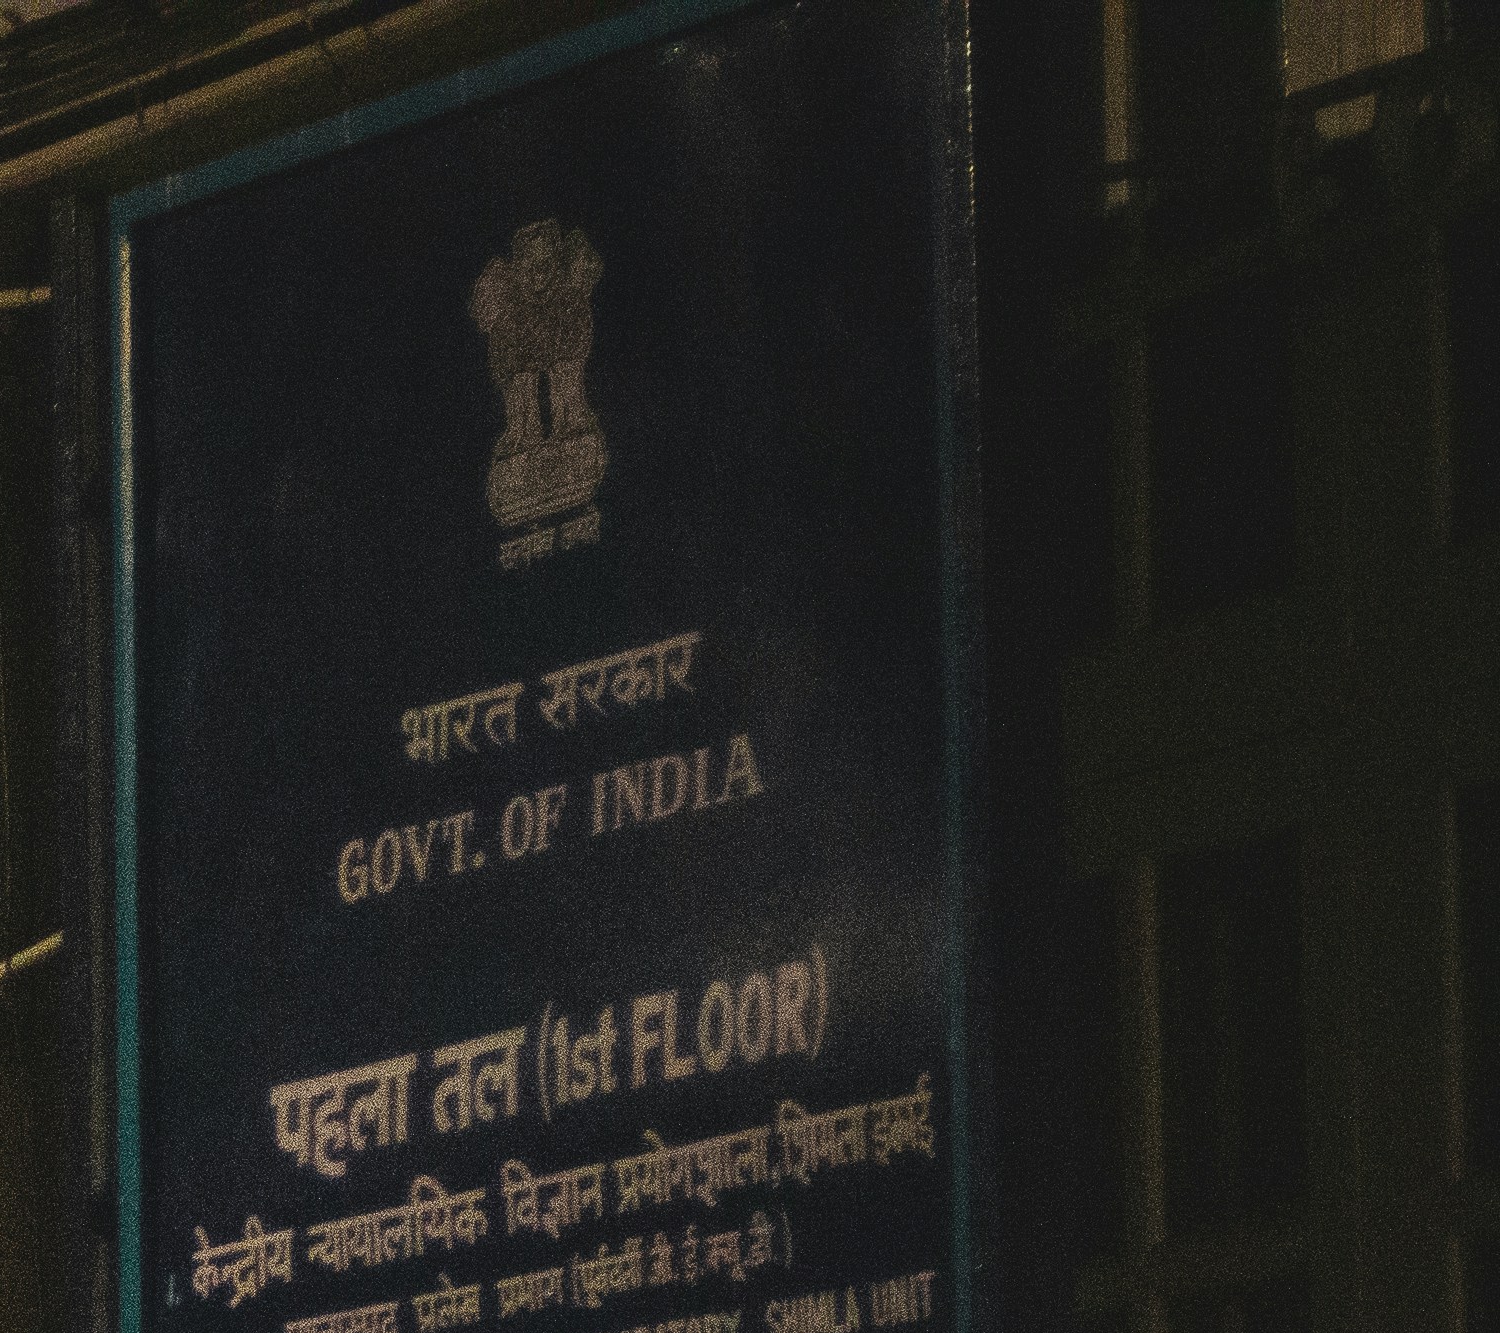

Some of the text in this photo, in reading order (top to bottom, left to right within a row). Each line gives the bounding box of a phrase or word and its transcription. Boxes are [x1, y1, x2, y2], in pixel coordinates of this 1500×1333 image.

[400, 631, 702, 762] भारत सरकार
[336, 732, 764, 904] GOVT. OF INDIA
[270, 944, 829, 1177] पहला तल (1st FLOOR)
[871, 1269, 937, 1328] UNIT
